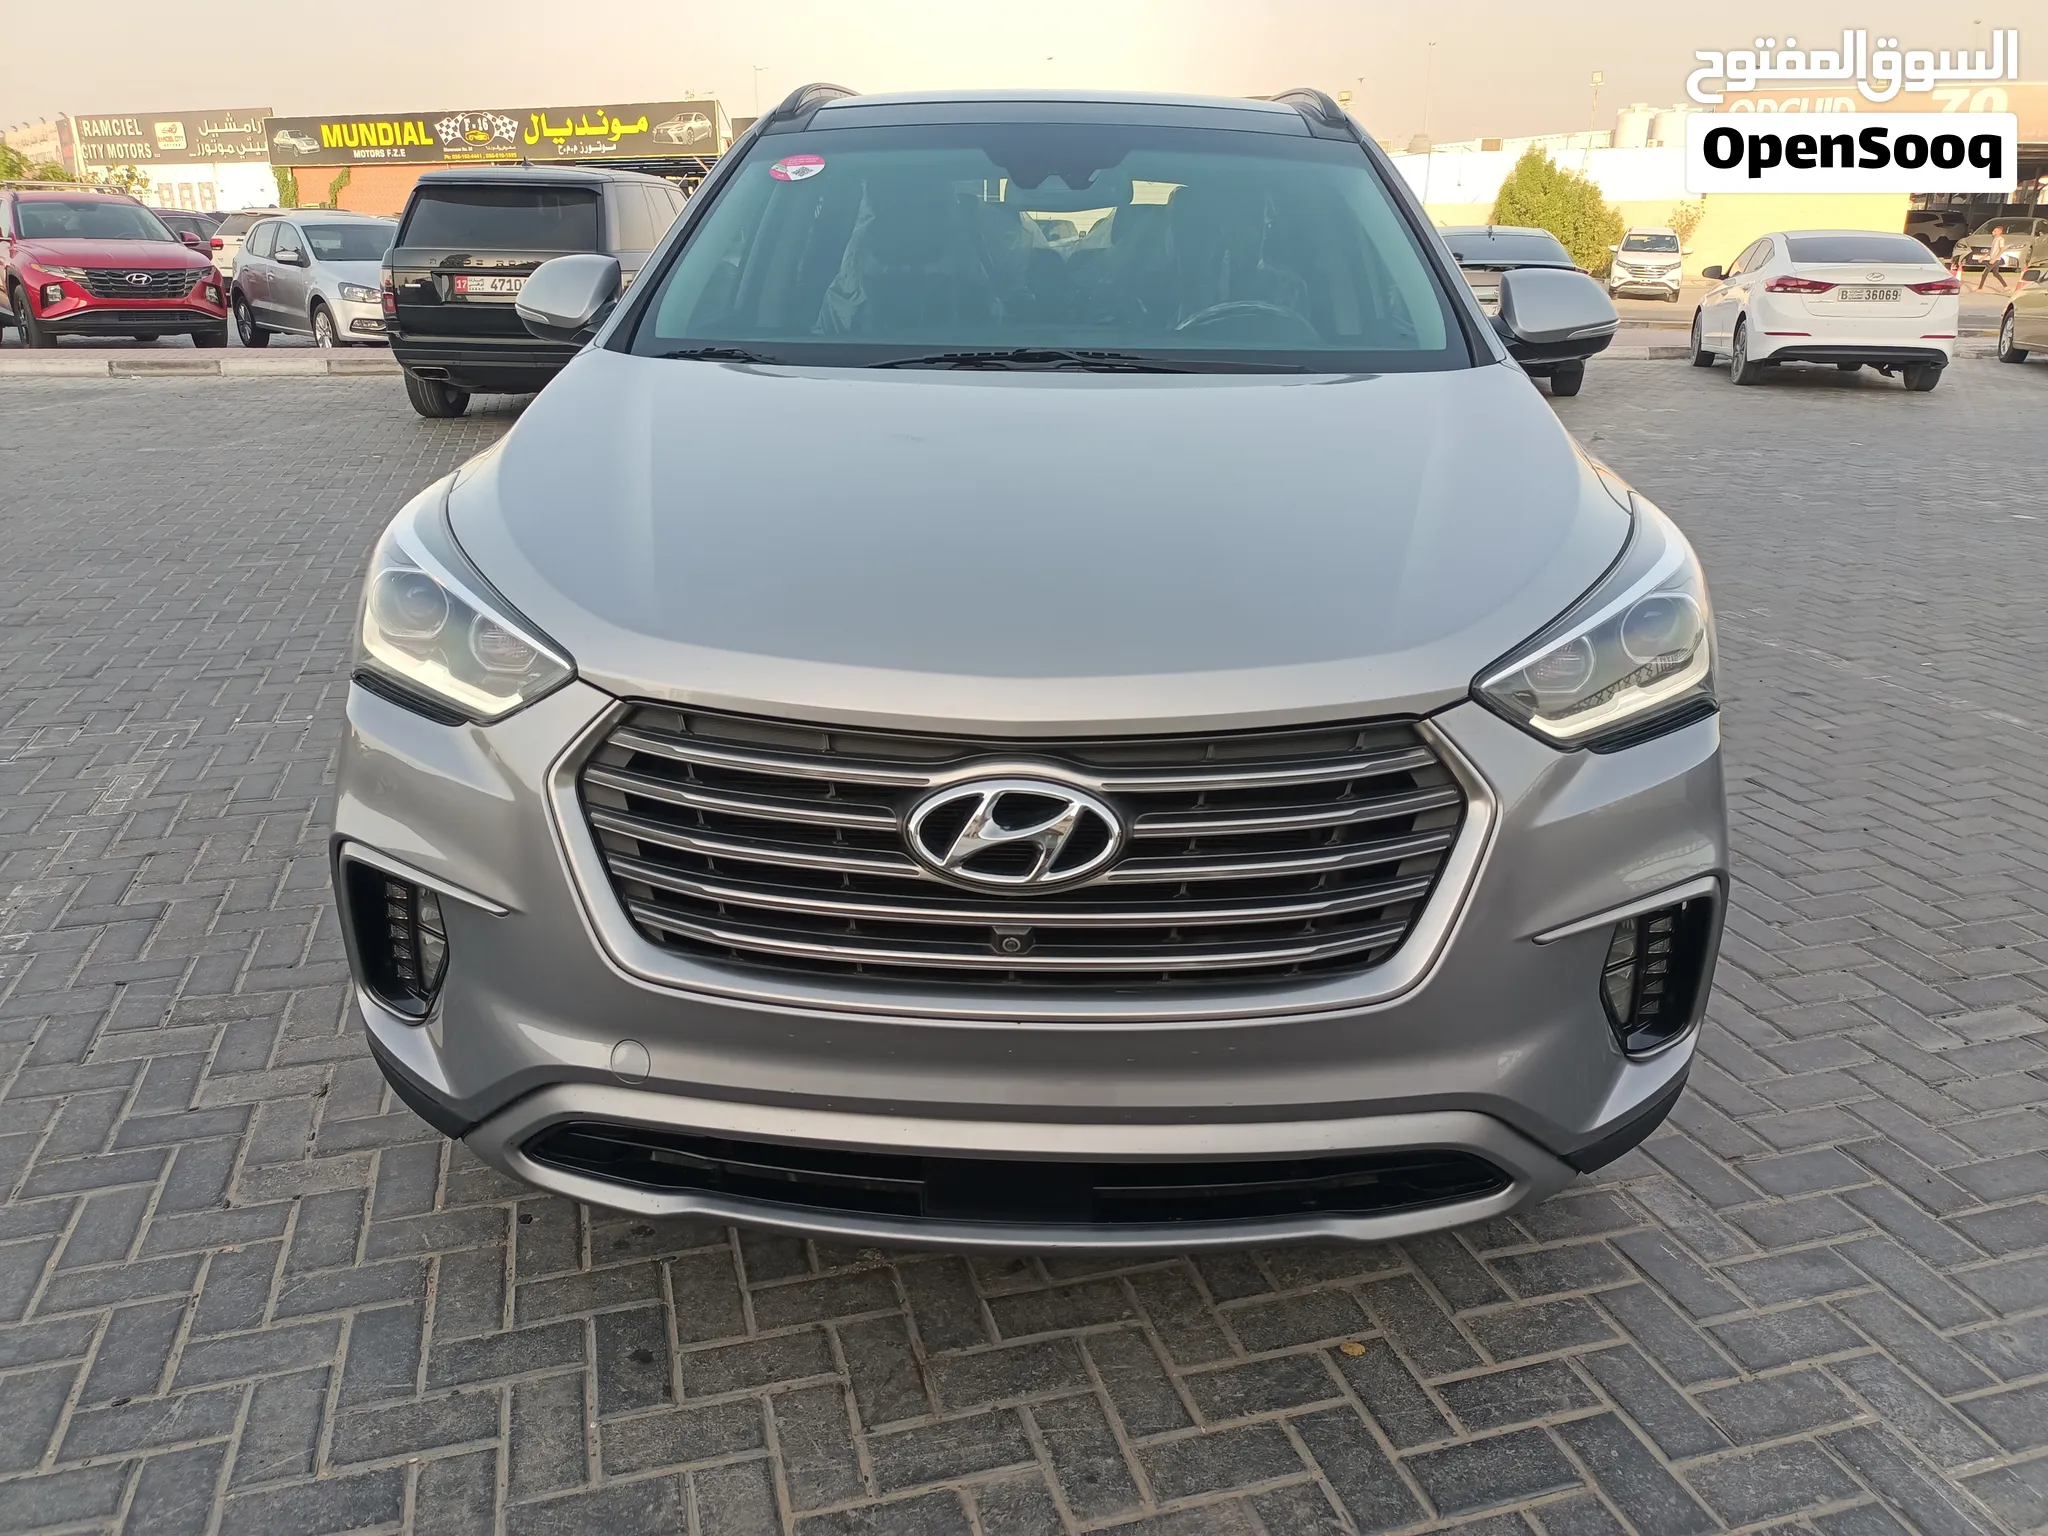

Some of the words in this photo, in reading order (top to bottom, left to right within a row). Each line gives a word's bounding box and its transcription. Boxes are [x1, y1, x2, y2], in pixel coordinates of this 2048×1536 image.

[82, 118, 143, 137] RAMCIEL
[198, 112, 263, 138] رامشيل
[523, 108, 649, 145] مونديال
[320, 121, 434, 148] MUNDIAL
[81, 143, 105, 160] CITY
[106, 142, 152, 160] MOTORS
[353, 149, 386, 159] MOTORS
[386, 148, 406, 158] F.Z.E
[579, 140, 617, 155] موتورز
[456, 279, 467, 289] 17
[490, 278, 527, 291] 4710
[1841, 291, 1848, 300] B
[1865, 290, 1899, 301] 36069
